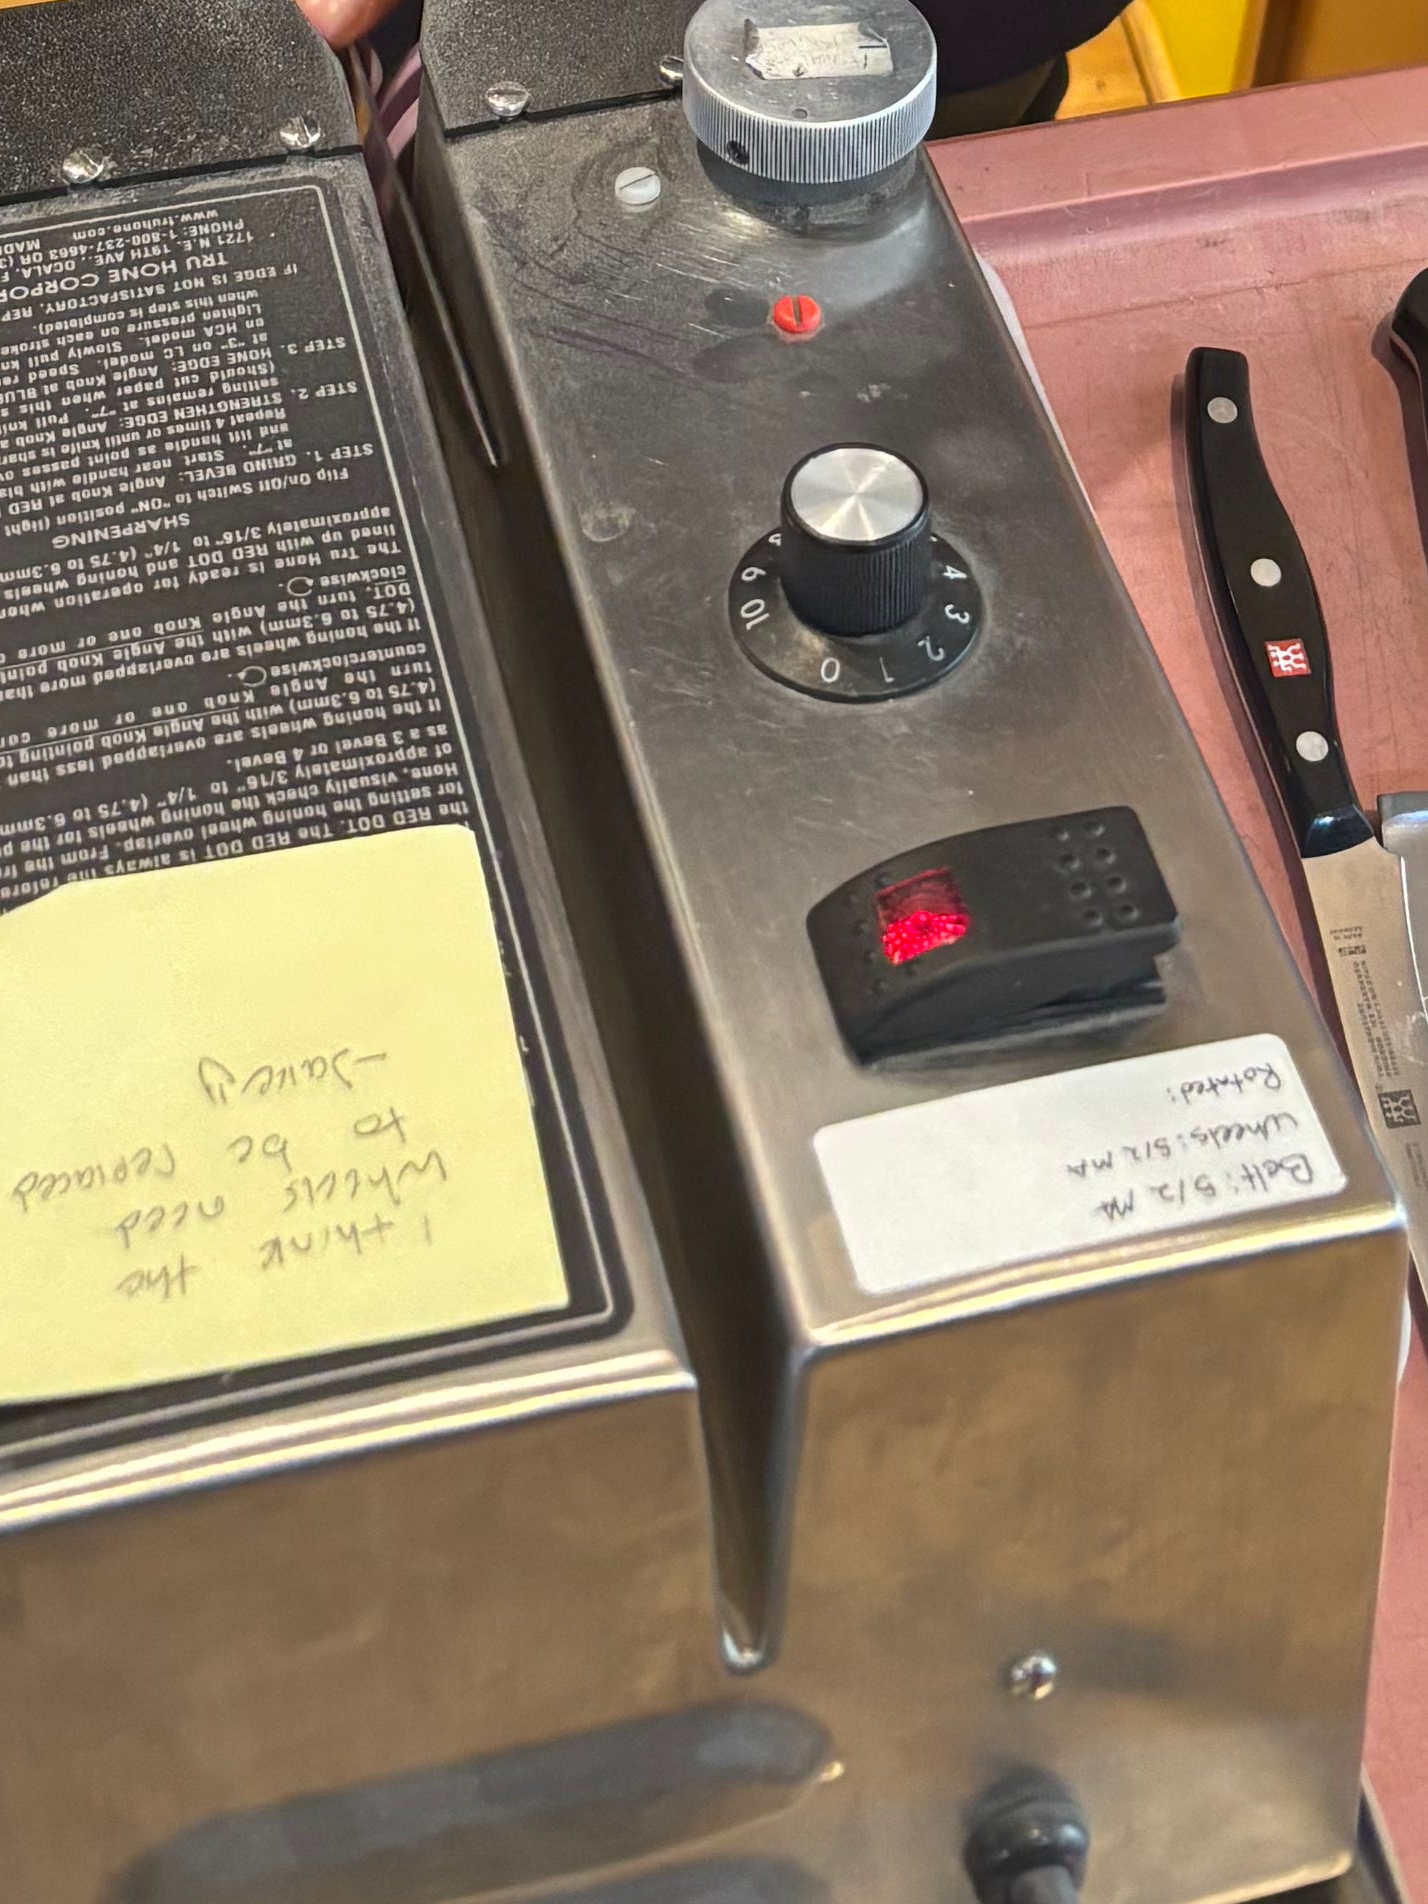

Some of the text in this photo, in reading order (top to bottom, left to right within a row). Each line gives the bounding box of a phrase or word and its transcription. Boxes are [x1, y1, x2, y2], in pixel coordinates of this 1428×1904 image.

[106, 258, 177, 283] HONE
[184, 250, 228, 271] TRU
[50, 511, 190, 550] SHARPENING
[942, 564, 968, 580] 4
[740, 598, 770, 631] 10
[944, 603, 969, 624] 3
[917, 635, 945, 662] 2
[820, 657, 841, 683] 0
[879, 656, 894, 682] 1
[1164, 1062, 1282, 1106] Rotated:
[10, 1105, 406, 1213] to be replaced
[1149, 1172, 1216, 1209] 5/2
[113, 1194, 225, 1251] need
[114, 1253, 199, 1302] the
